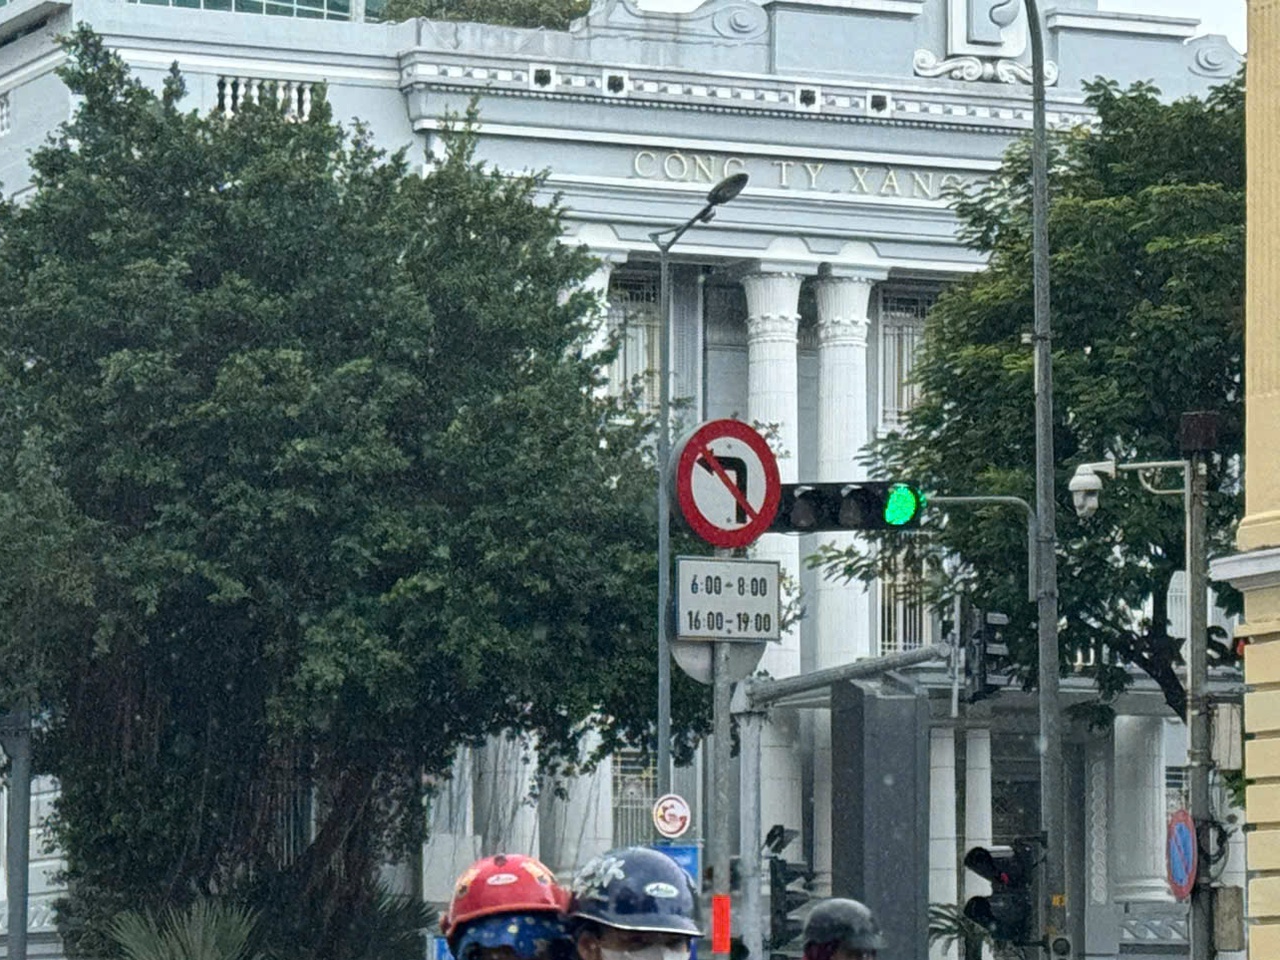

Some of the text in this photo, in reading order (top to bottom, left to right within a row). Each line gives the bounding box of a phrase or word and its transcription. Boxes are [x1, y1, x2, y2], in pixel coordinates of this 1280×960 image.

[772, 160, 824, 189] TY
[691, 574, 722, 595] 6:00
[738, 576, 767, 597] 8:00
[687, 609, 723, 631] 16:00
[737, 611, 771, 633] 19:00
